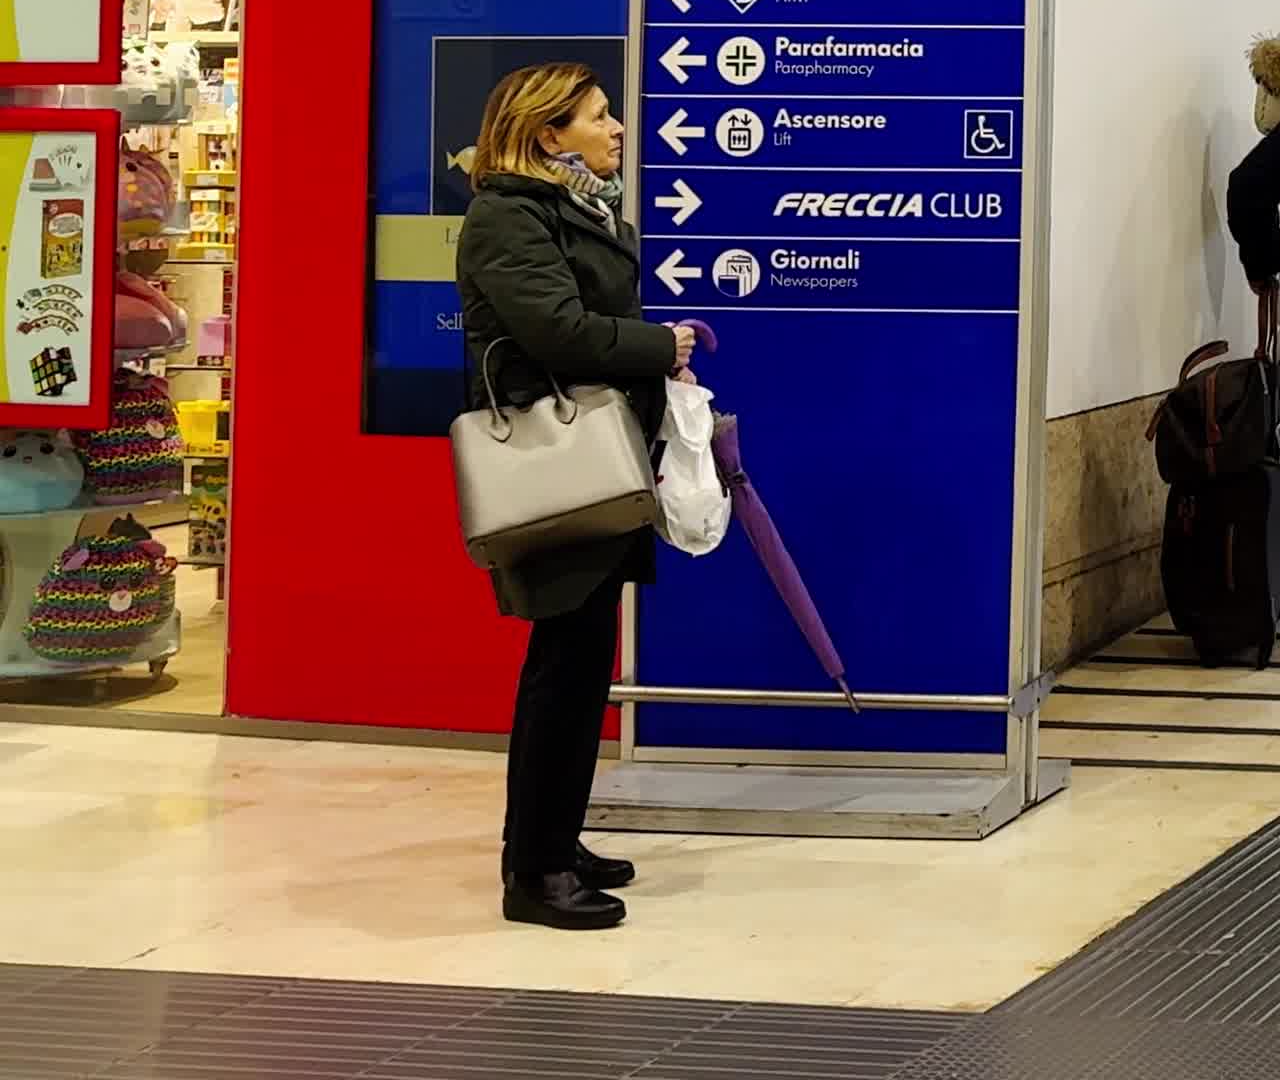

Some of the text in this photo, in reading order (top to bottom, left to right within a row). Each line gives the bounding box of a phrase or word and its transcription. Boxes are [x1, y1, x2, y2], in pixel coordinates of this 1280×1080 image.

[775, 37, 923, 58] Parafarmacia
[775, 61, 874, 77] Parapharmacy
[773, 109, 886, 128] Ascensore
[774, 133, 792, 146] Lift
[773, 193, 1002, 218] FRECCIA CLUB
[770, 249, 859, 270] Giornali
[770, 274, 858, 290] Newspapers
